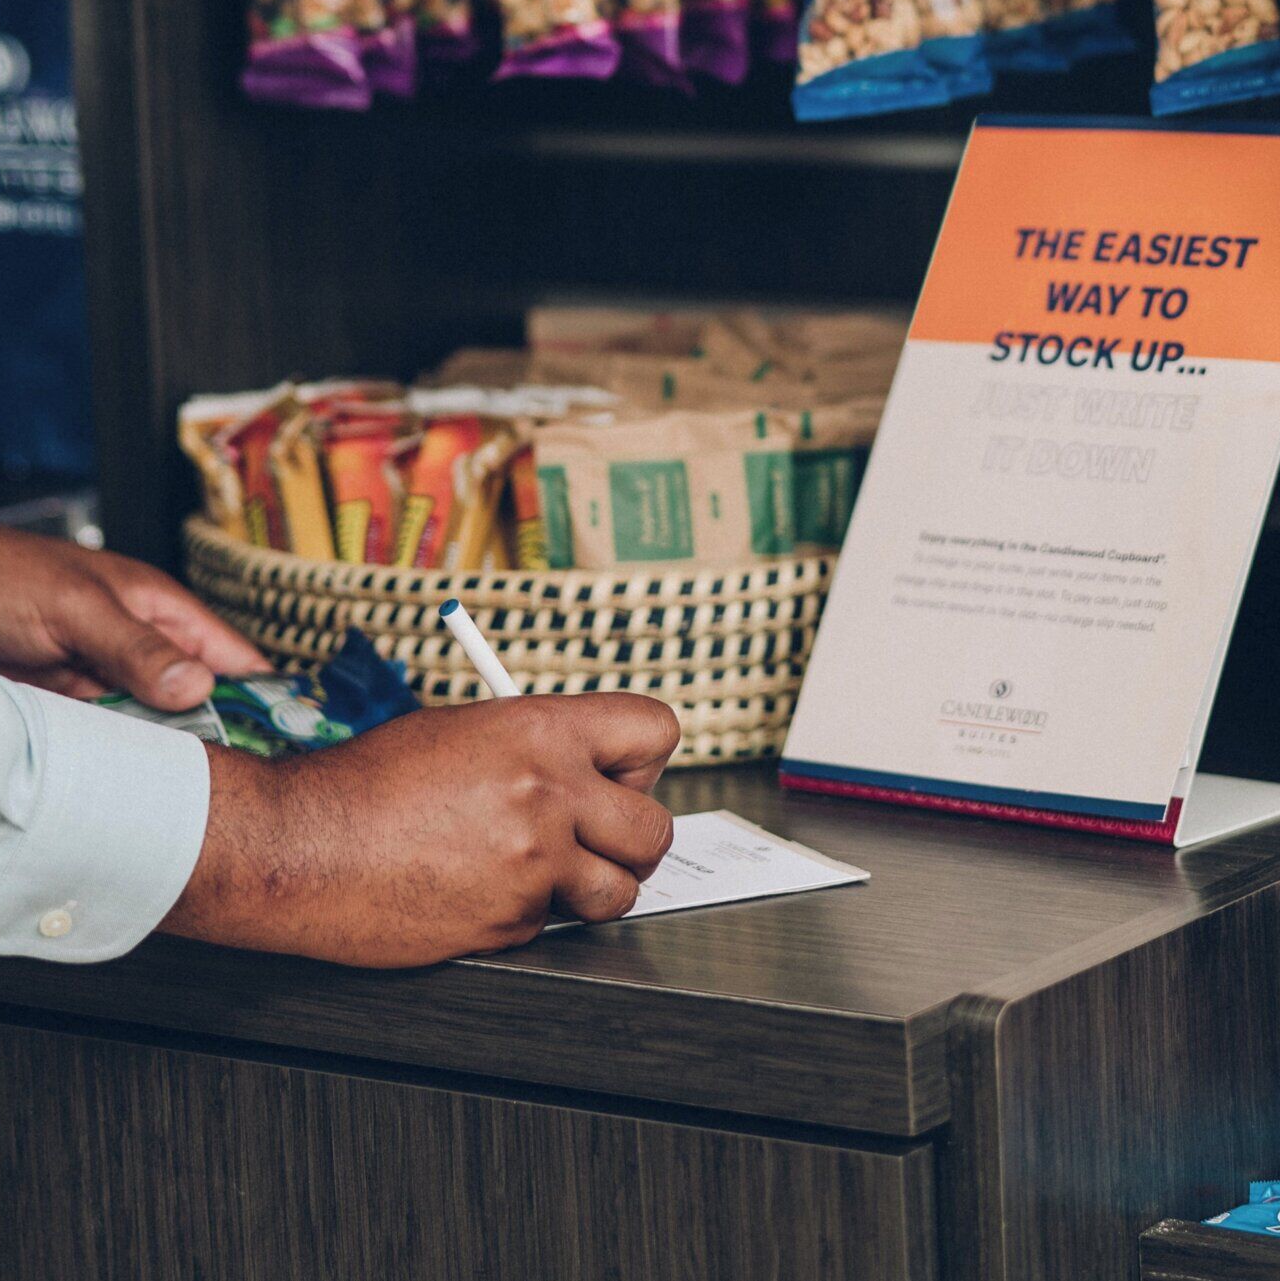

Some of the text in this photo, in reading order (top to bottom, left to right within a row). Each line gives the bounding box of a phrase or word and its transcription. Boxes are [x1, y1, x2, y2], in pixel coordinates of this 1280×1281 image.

[1014, 229, 1258, 269] THE EASIEST
[1047, 283, 1189, 319] WAY TO
[990, 332, 1208, 375] STOCK UP...
